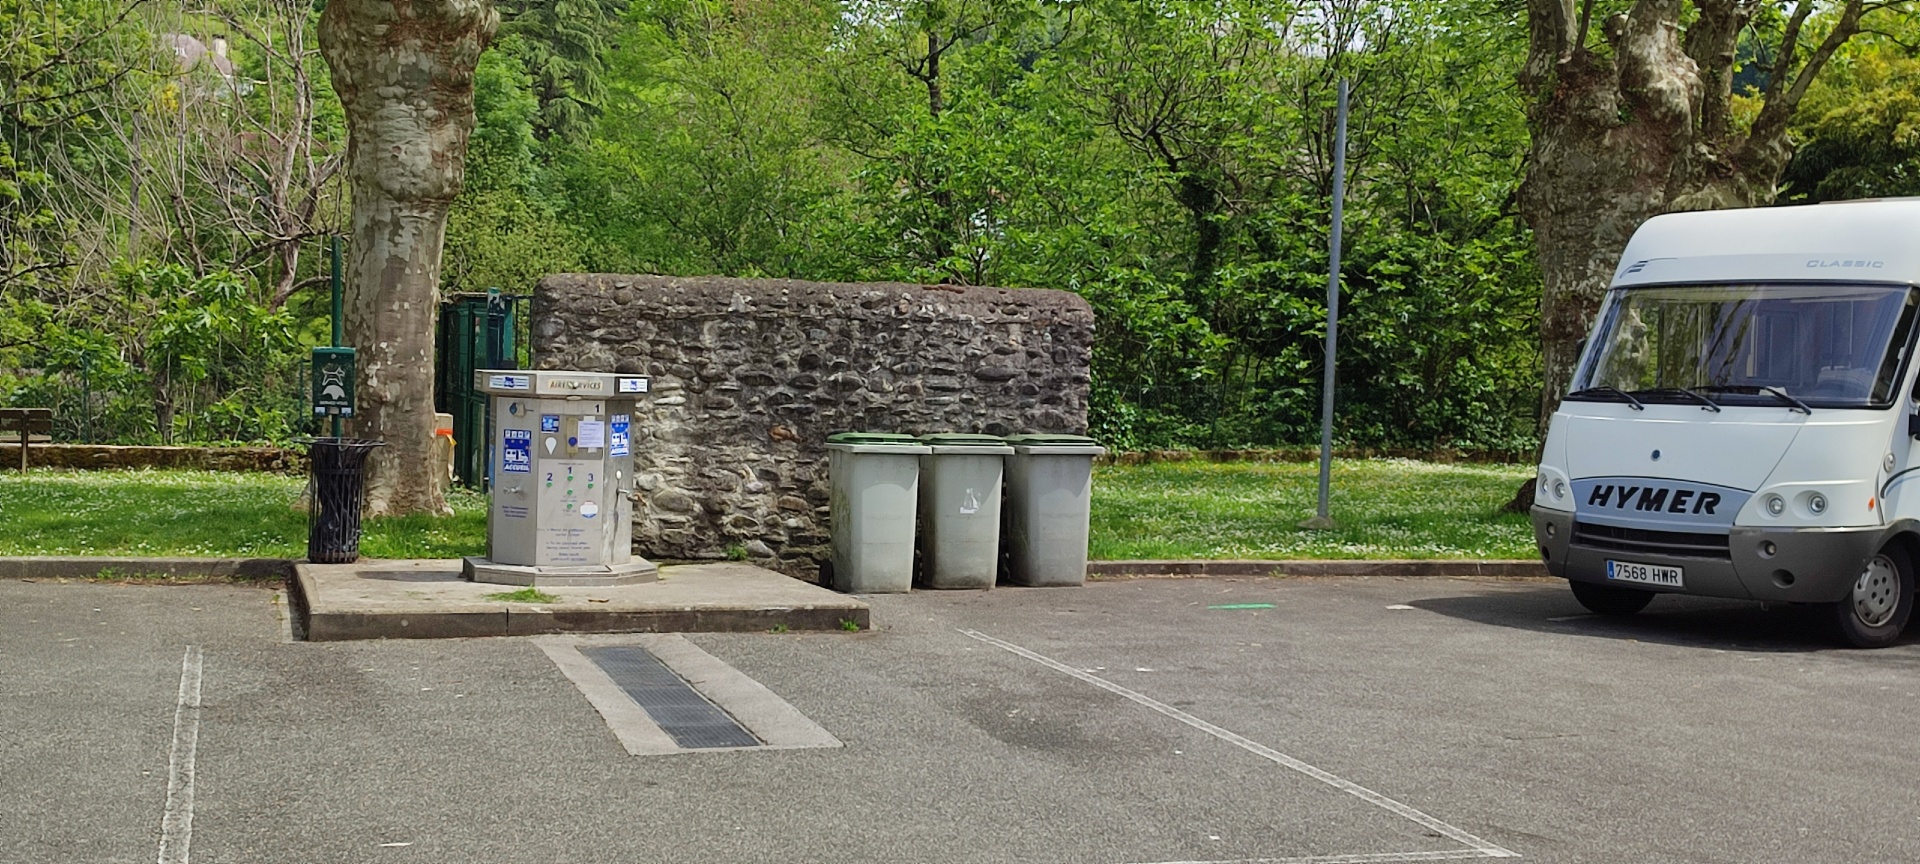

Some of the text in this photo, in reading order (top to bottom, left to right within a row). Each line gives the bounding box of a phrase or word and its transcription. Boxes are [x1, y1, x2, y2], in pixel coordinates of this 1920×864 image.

[1805, 259, 1885, 269] CLASSIC
[595, 404, 600, 413] 1
[567, 466, 572, 474] 1
[546, 472, 553, 481] 2
[588, 473, 594, 482] 3
[1588, 485, 1721, 514] HYMER
[1615, 563, 1679, 584] 7568 HWR
